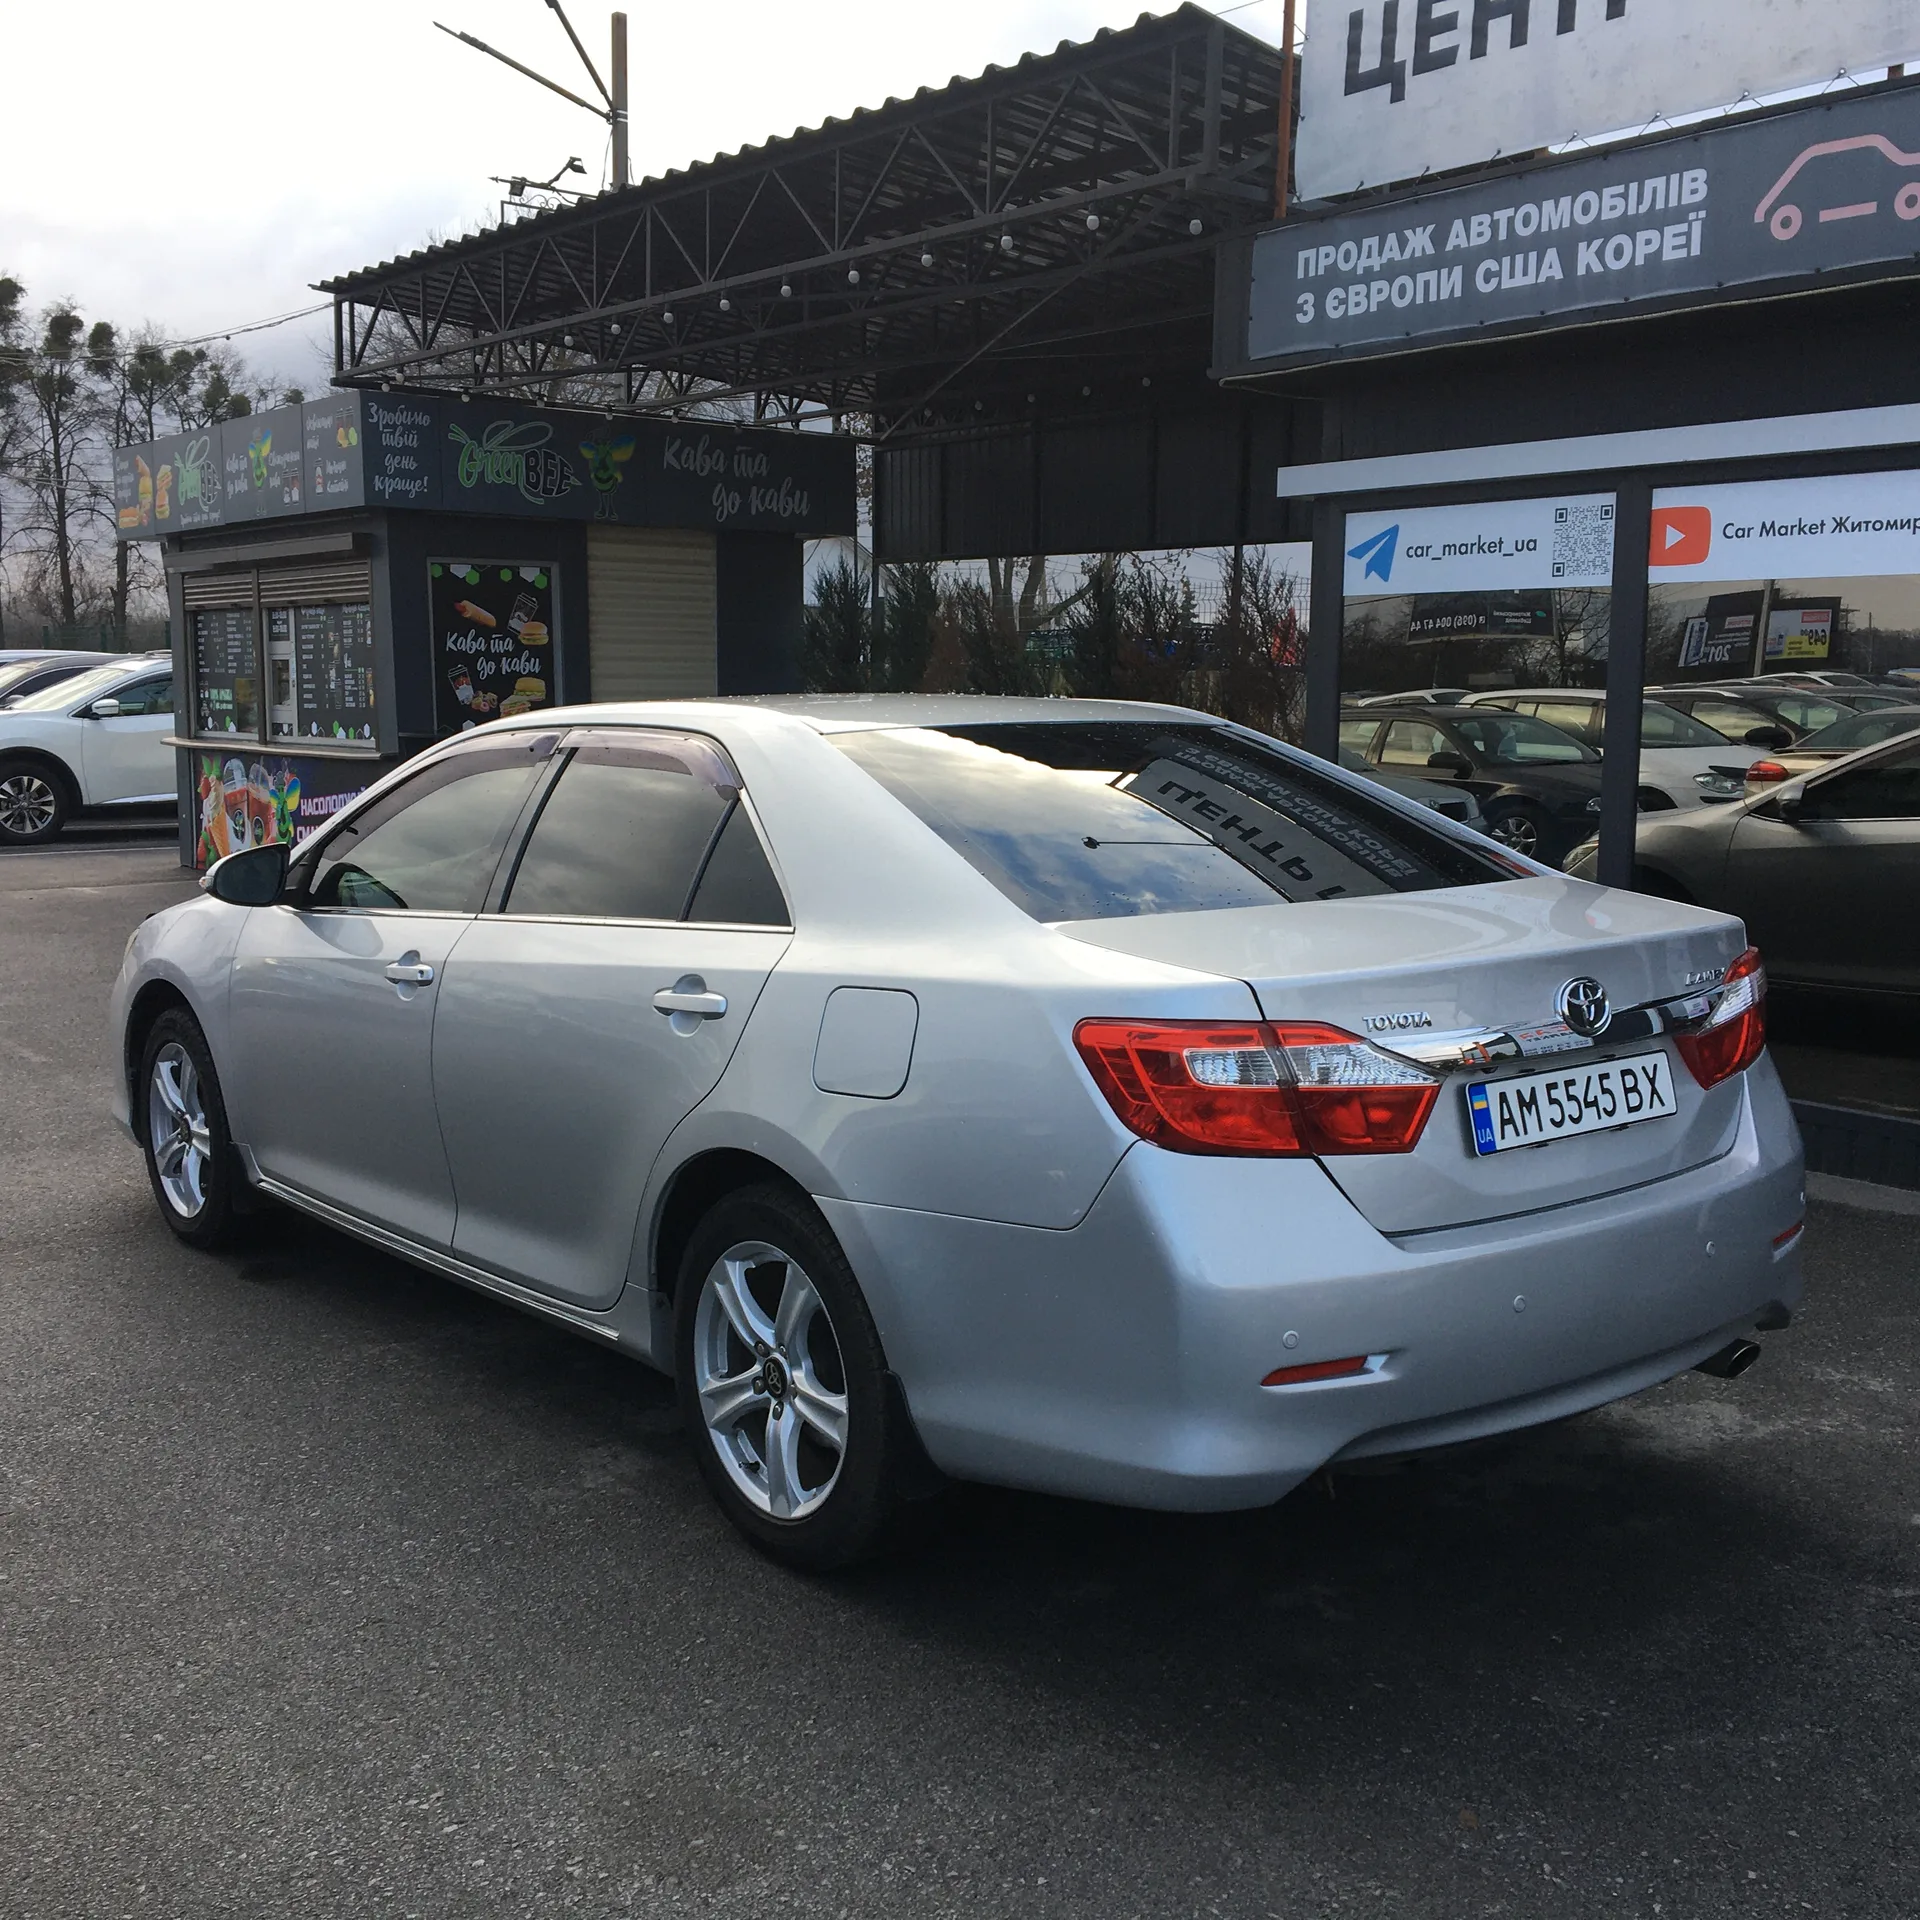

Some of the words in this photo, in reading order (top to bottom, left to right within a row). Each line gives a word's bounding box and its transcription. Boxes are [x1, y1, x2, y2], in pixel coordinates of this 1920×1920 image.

[1344, 0, 1626, 104] ЦЕН
[1297, 224, 1436, 279] ПРОДАЖ
[1445, 168, 1708, 251] АВТОМОБІЛІВ
[1295, 292, 1315, 323] З
[1325, 265, 1463, 319] ЄВРОПИ
[1475, 248, 1564, 293] США
[1577, 210, 1707, 276] КОРЕЇ
[368, 402, 431, 431] Зробимо
[382, 426, 419, 448] твій
[384, 453, 419, 474] день
[663, 434, 728, 476] Кава
[733, 445, 770, 478] та
[373, 475, 429, 499] краще!
[712, 483, 743, 523] до
[748, 476, 811, 517] кави
[1722, 523, 1754, 539] Car
[1759, 517, 1827, 538] Market
[1406, 535, 1538, 560] car_market_ua
[446, 628, 488, 655] Кава
[490, 633, 515, 653] та
[477, 656, 497, 680] до
[500, 650, 542, 675] кави
[1362, 1011, 1433, 1032] TOYOTA
[1478, 1127, 1494, 1144] UA
